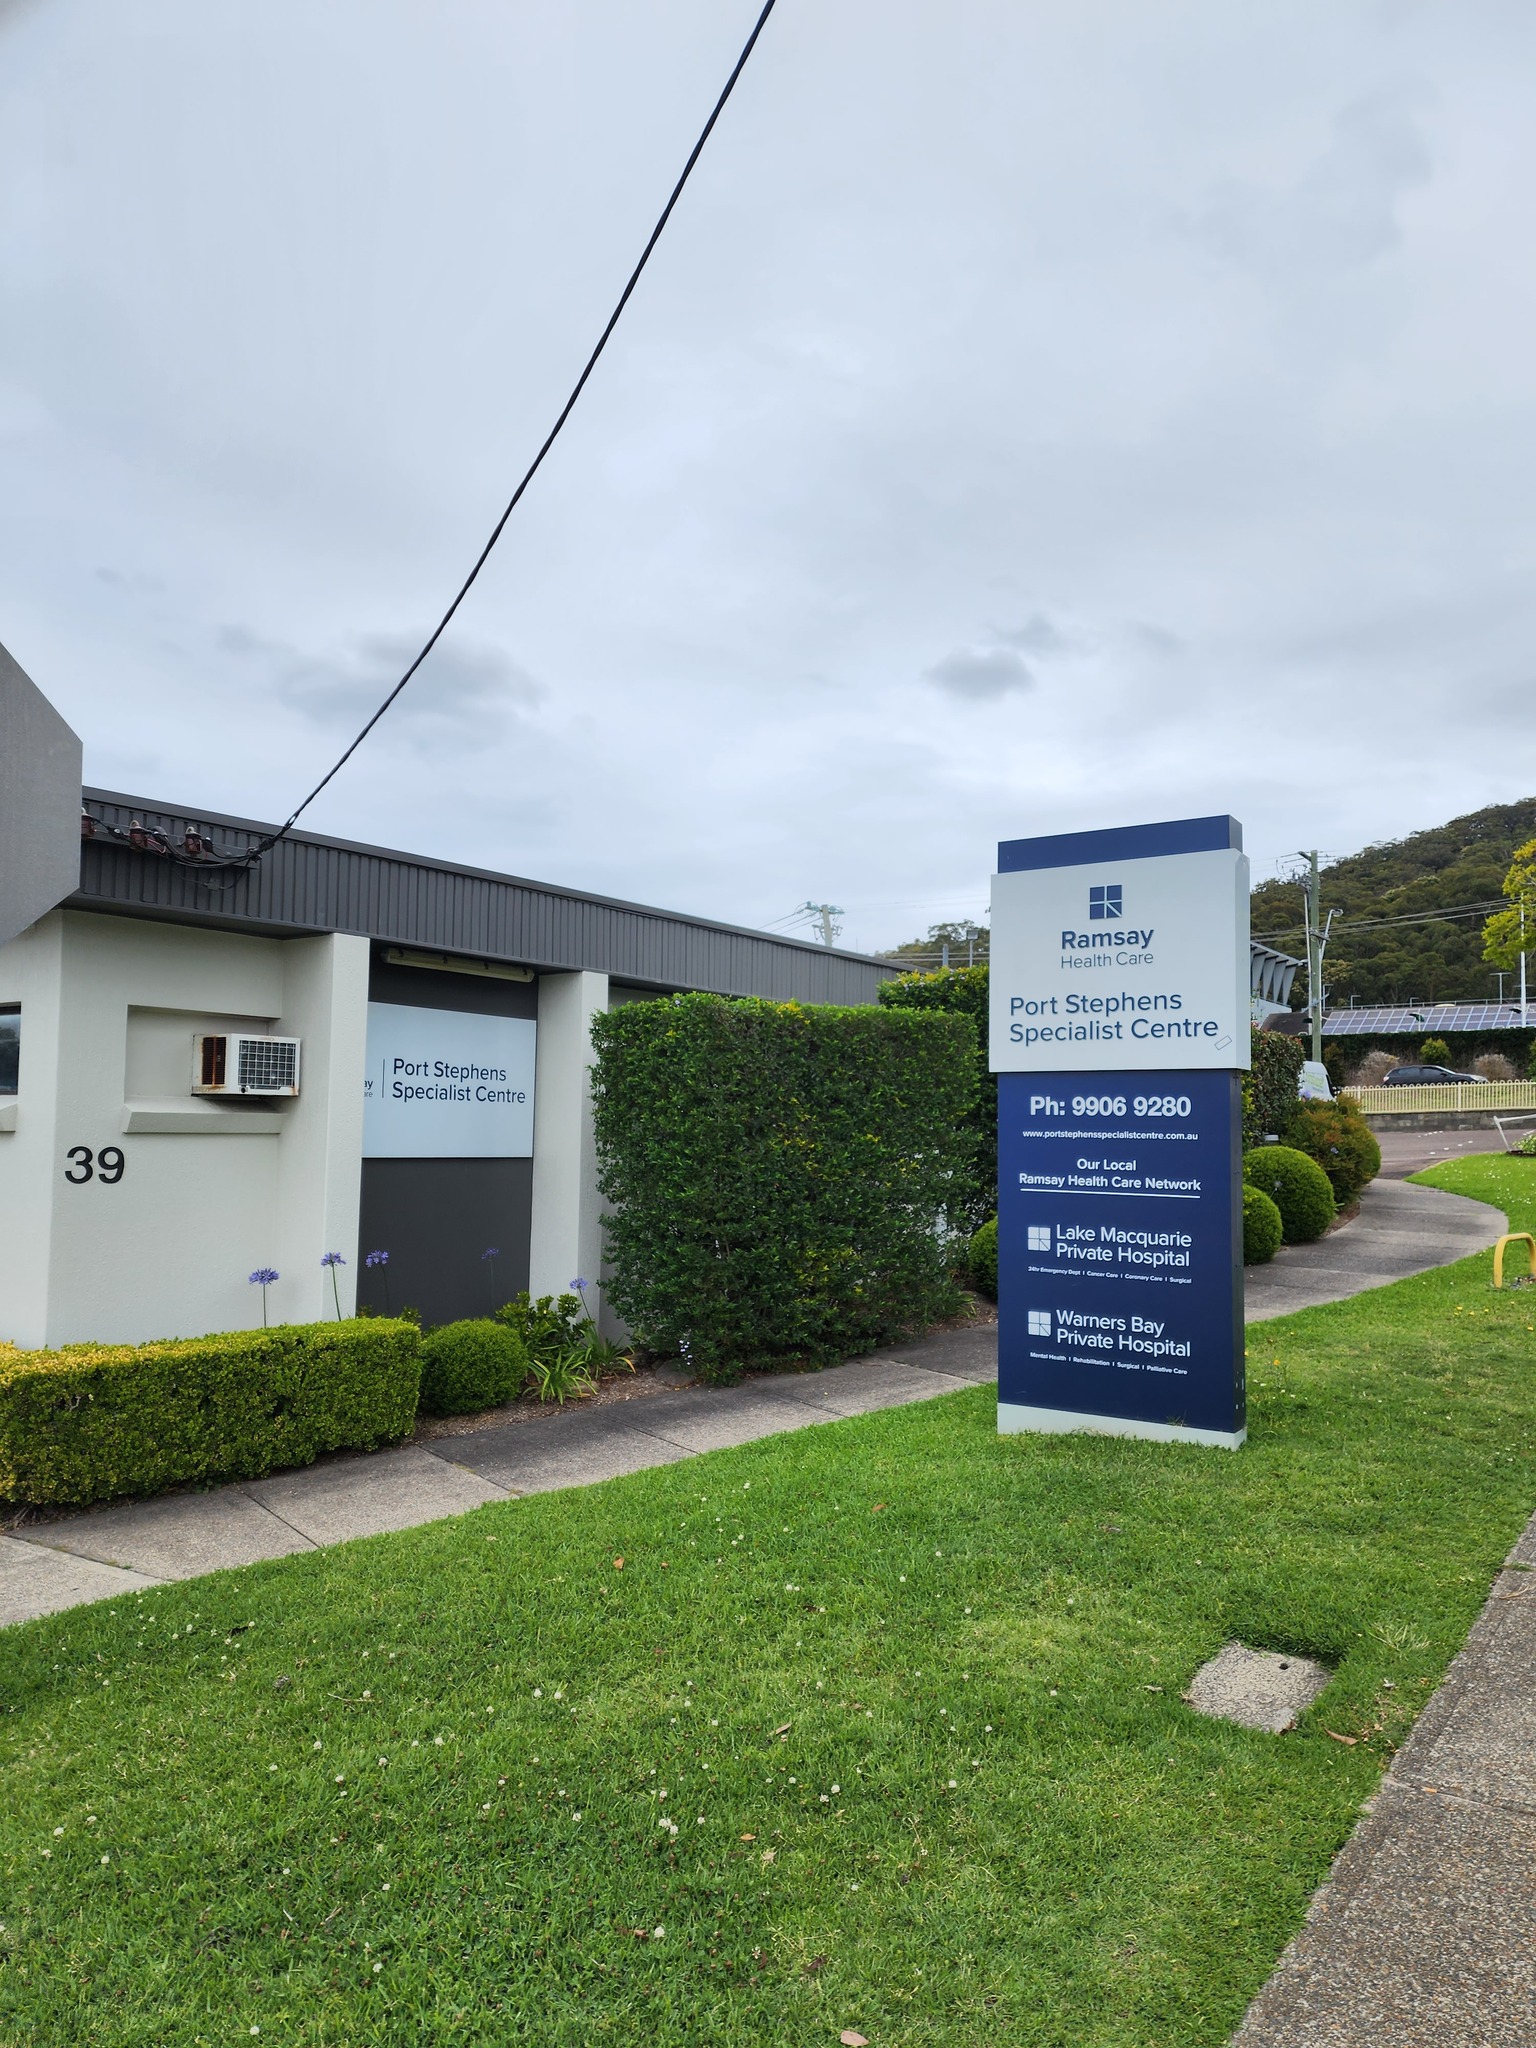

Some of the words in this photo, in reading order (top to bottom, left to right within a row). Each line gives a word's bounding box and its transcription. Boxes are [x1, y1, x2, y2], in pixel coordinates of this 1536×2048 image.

[1061, 929, 1154, 950] Ramsay
[1061, 953, 1112, 969] Health
[1115, 951, 1154, 967] Care
[1010, 996, 1058, 1016] Port
[1065, 992, 1182, 1017] Stephens
[1010, 1020, 1123, 1047] Specialist
[1131, 1018, 1219, 1039] Centre
[393, 1058, 429, 1077] Port
[433, 1061, 507, 1083] Stephens
[392, 1081, 471, 1103] Specialist
[475, 1085, 526, 1104] Centre
[1030, 1096, 1066, 1116] Ph:
[1072, 1096, 1127, 1117] 9906
[1133, 1096, 1192, 1117] 9280
[1022, 1130, 1199, 1141] www.portstephensspecialistcentre.com.au
[64, 1145, 125, 1185] 39
[1077, 1158, 1100, 1171] Our
[1103, 1159, 1137, 1172] Local
[1019, 1173, 1065, 1188] Ramsay
[1067, 1174, 1108, 1188] Health
[1111, 1176, 1142, 1189] Care
[1145, 1177, 1201, 1191] Network
[1056, 1224, 1096, 1242] Lake
[1101, 1226, 1192, 1250] Macquarie
[1056, 1243, 1113, 1262] Private
[1118, 1246, 1190, 1269] Hospital
[1040, 1267, 1068, 1276] Emergency
[1125, 1273, 1149, 1282] Coronary
[1169, 1276, 1192, 1285] Surgical
[1056, 1309, 1126, 1332] Warners
[1131, 1316, 1164, 1337] Bay
[1056, 1328, 1113, 1349] Private
[1119, 1334, 1191, 1358] Hospital
[1030, 1351, 1048, 1360] Mental
[1048, 1353, 1067, 1362] Health
[1072, 1356, 1110, 1366] Rehabilitation
[1117, 1361, 1140, 1370] Surgical
[1146, 1365, 1172, 1374] Palliative
[1173, 1367, 1188, 1375] Care
